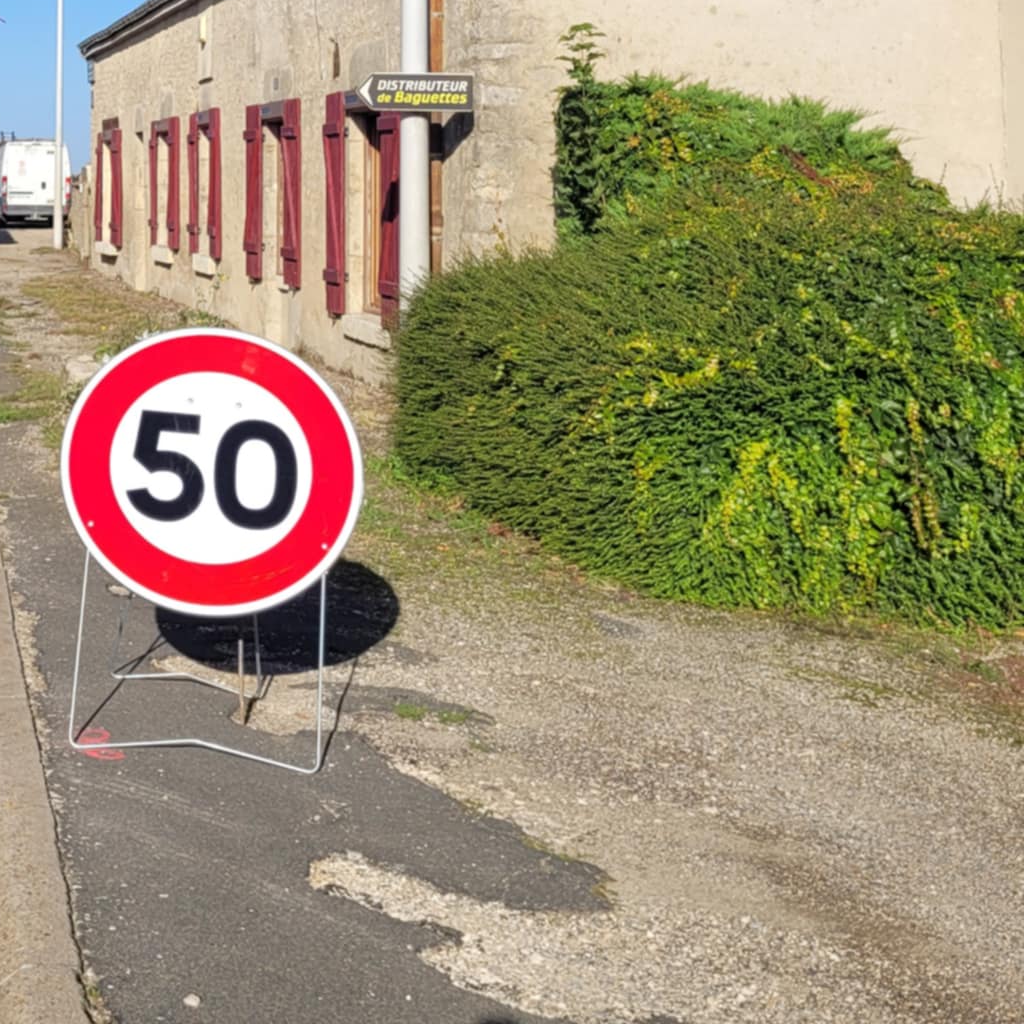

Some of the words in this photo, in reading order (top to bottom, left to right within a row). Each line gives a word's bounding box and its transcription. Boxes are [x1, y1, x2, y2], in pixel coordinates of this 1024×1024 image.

[377, 79, 468, 92] DISTRIBUTEUR
[377, 93, 392, 103] de
[394, 91, 468, 105] Baguettes
[126, 409, 298, 530] 50
